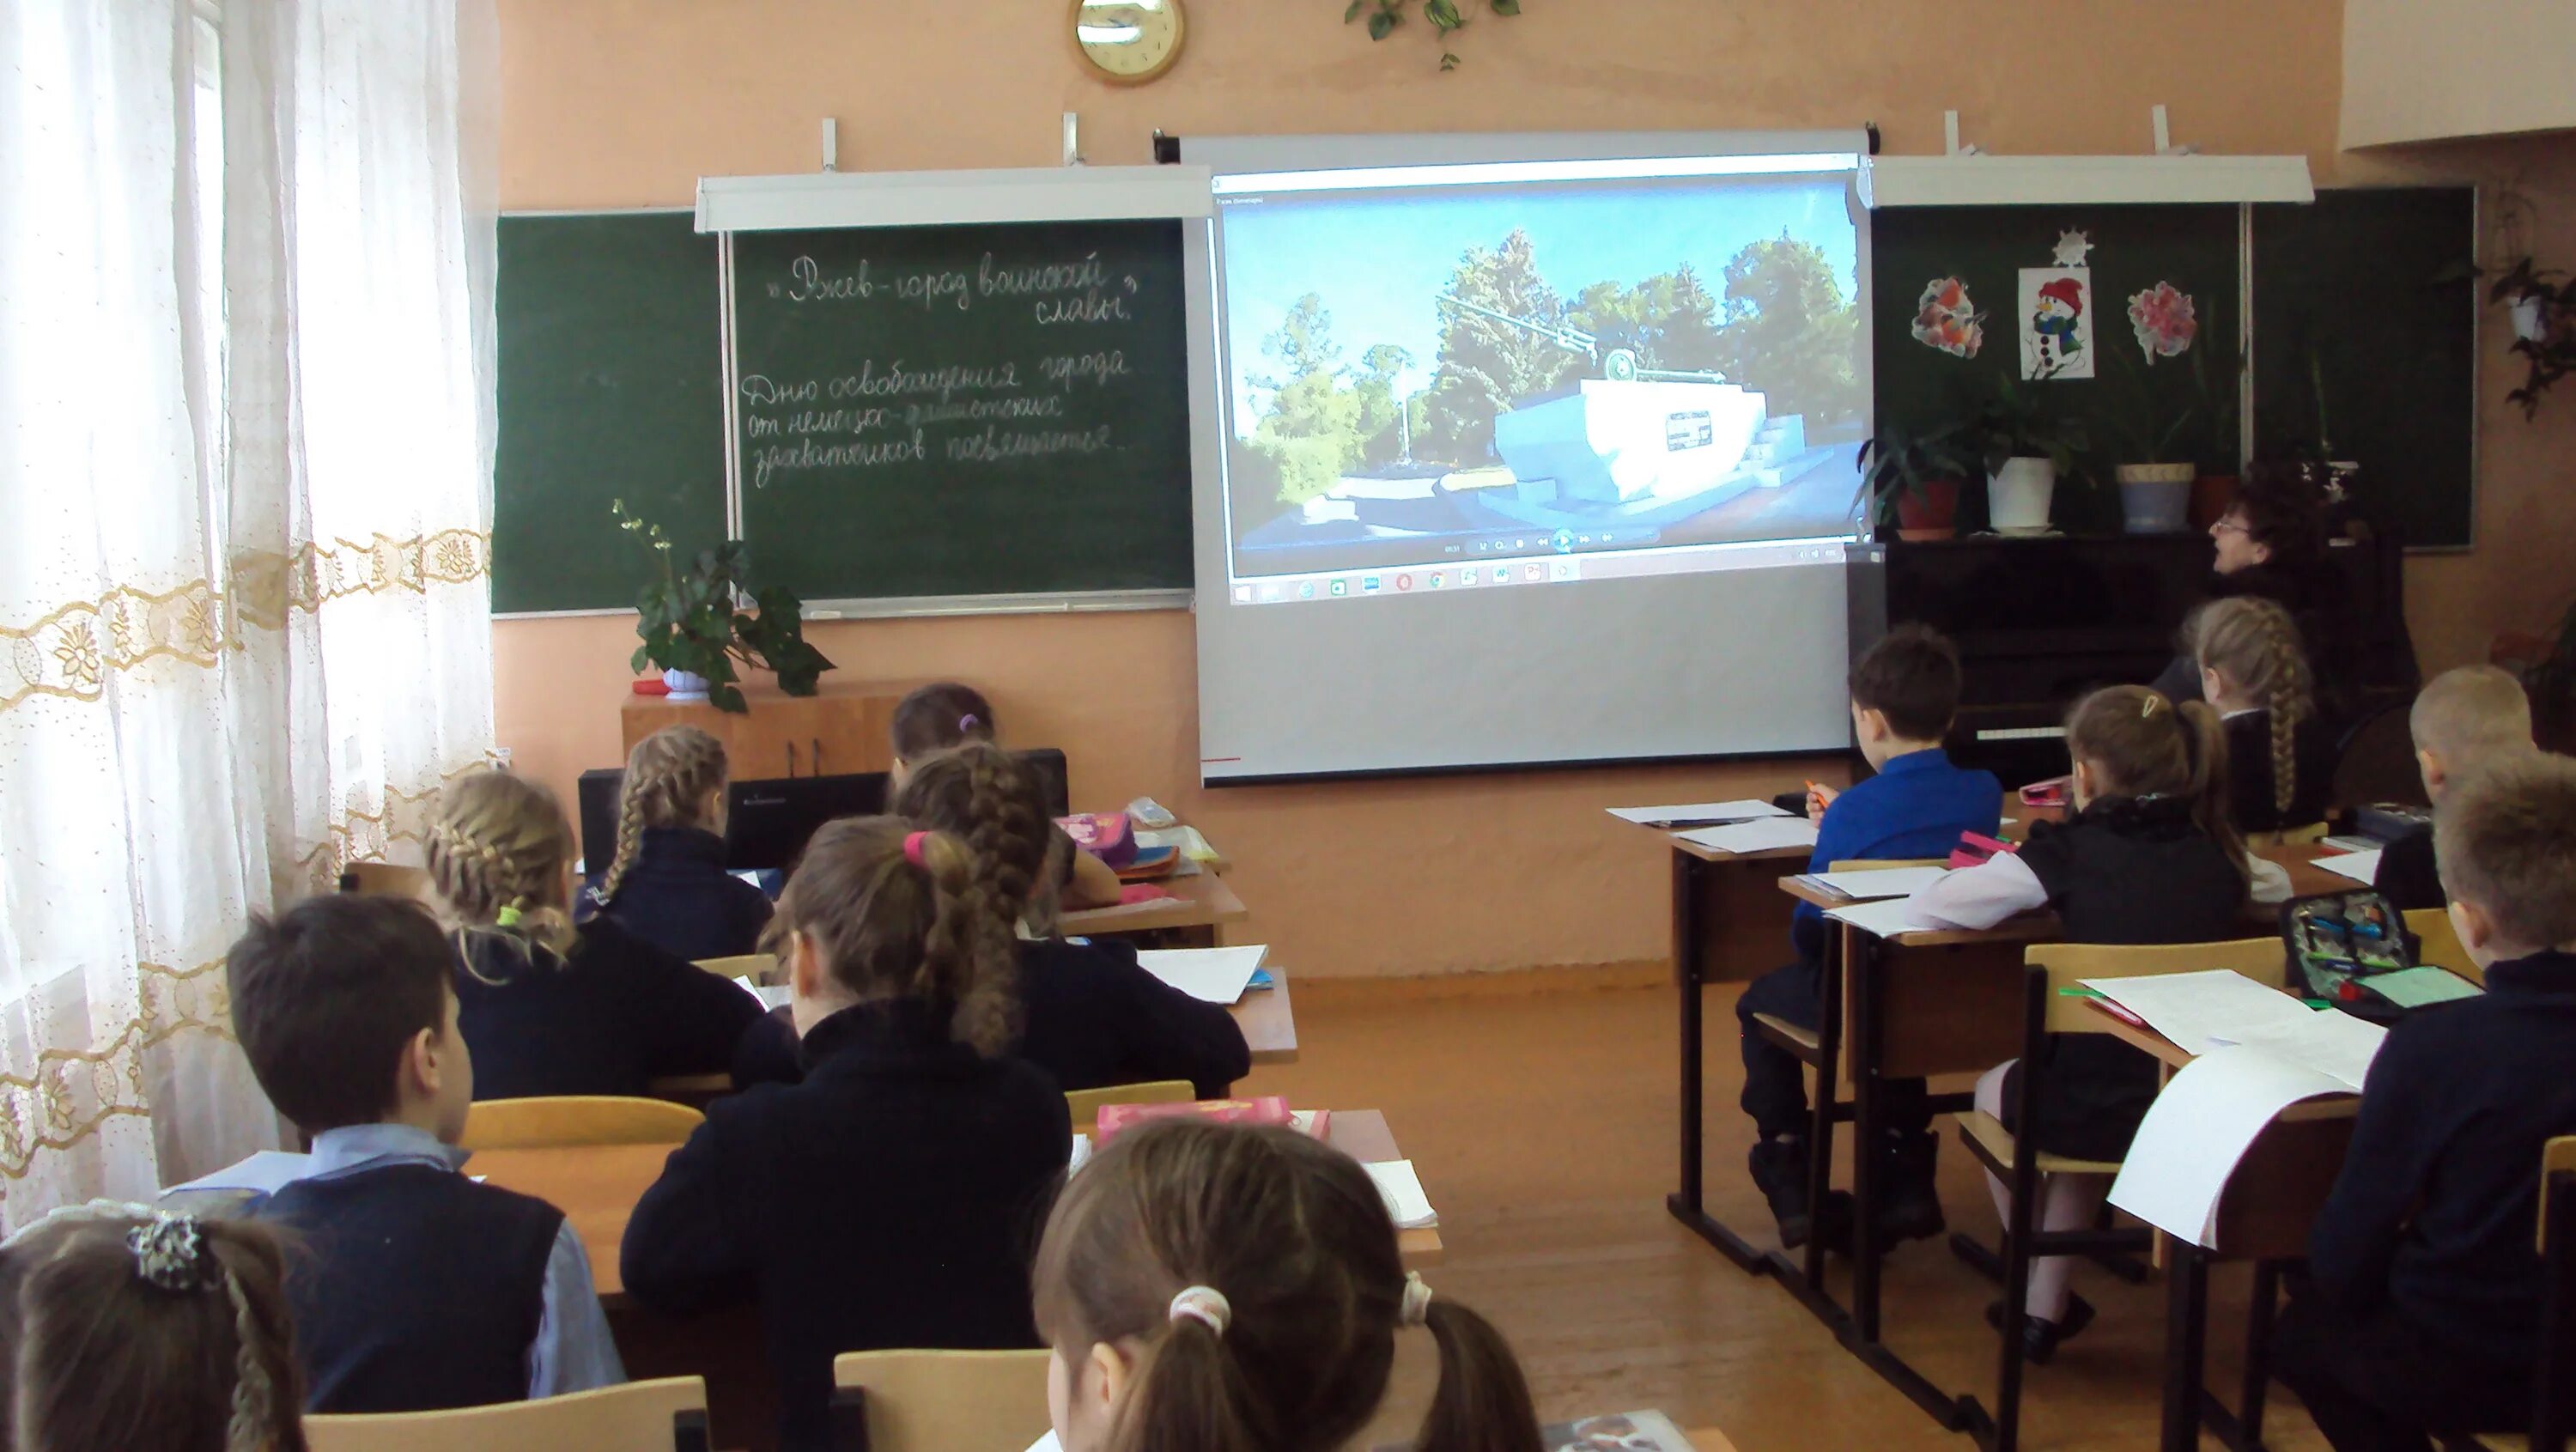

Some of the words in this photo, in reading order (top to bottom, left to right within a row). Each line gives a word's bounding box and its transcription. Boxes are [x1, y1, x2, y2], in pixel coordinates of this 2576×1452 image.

[742, 374, 818, 405] Дню
[1039, 350, 1130, 393] города
[749, 414, 780, 438] от
[752, 428, 926, 488] захватчиков
